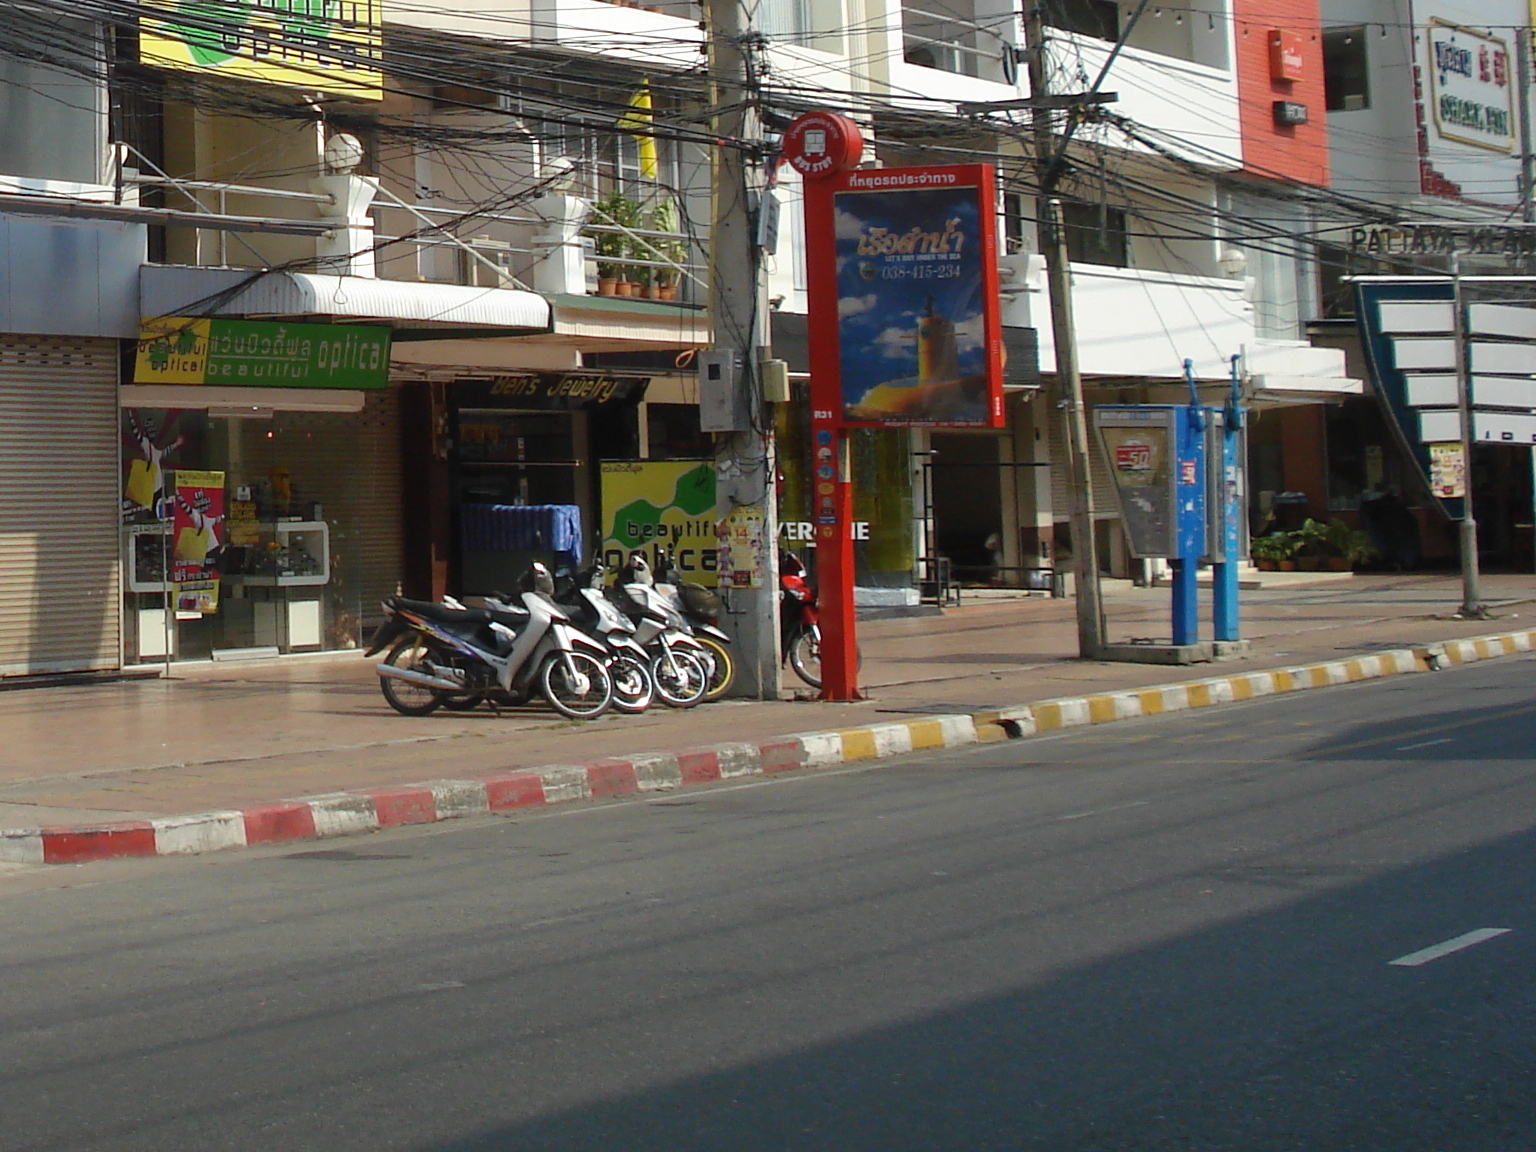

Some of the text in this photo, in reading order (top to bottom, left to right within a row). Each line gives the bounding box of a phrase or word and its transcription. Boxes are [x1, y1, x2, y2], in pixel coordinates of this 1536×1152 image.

[794, 155, 832, 173] BUS STOP
[317, 333, 391, 376] optical
[151, 358, 204, 374] optical
[207, 360, 309, 378] beautiful
[547, 375, 618, 404] Jewelry
